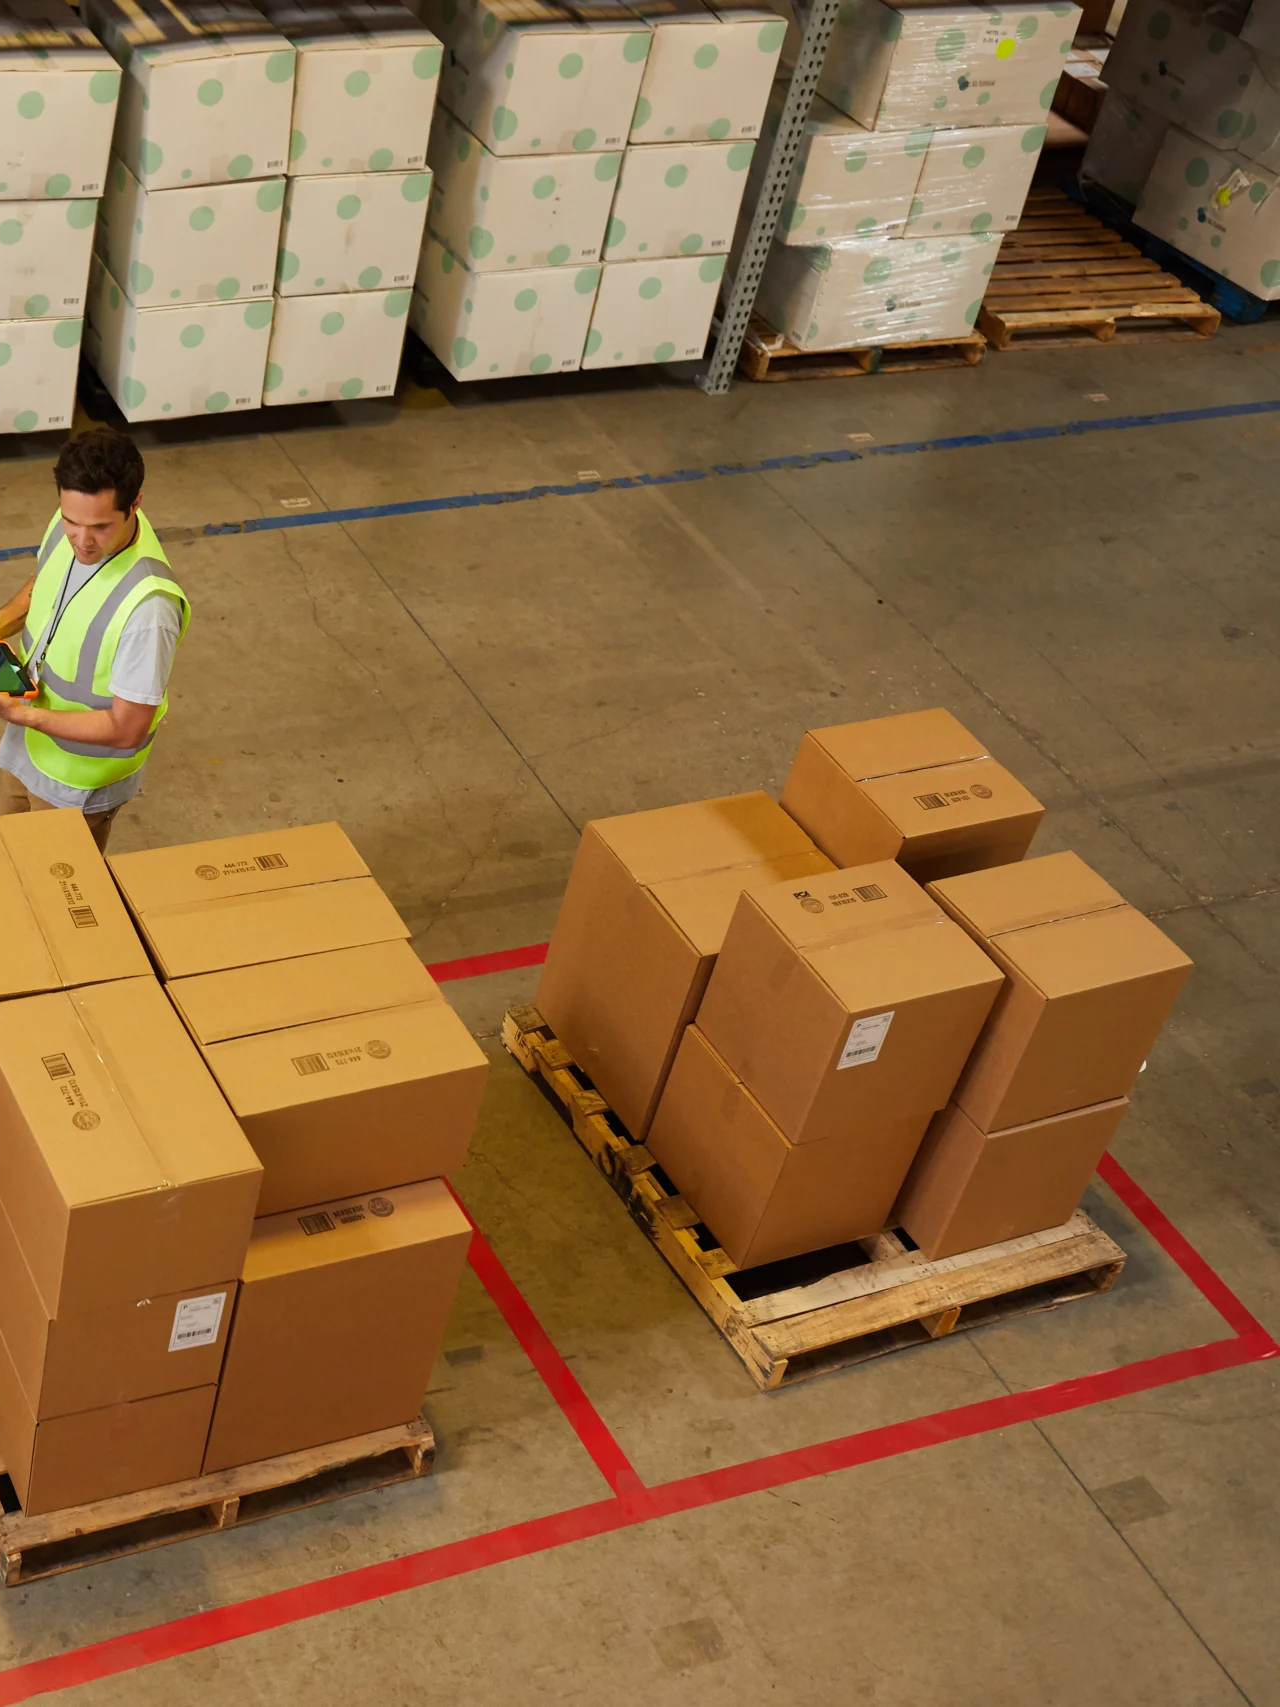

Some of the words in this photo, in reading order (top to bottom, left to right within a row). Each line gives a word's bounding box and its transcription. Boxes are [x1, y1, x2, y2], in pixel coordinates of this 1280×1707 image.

[224, 861, 248, 869] 444-773
[70, 883, 84, 901] 444-773
[792, 891, 811, 899] PCA
[335, 1055, 362, 1066] 444-773
[60, 1085, 75, 1106] 444-773
